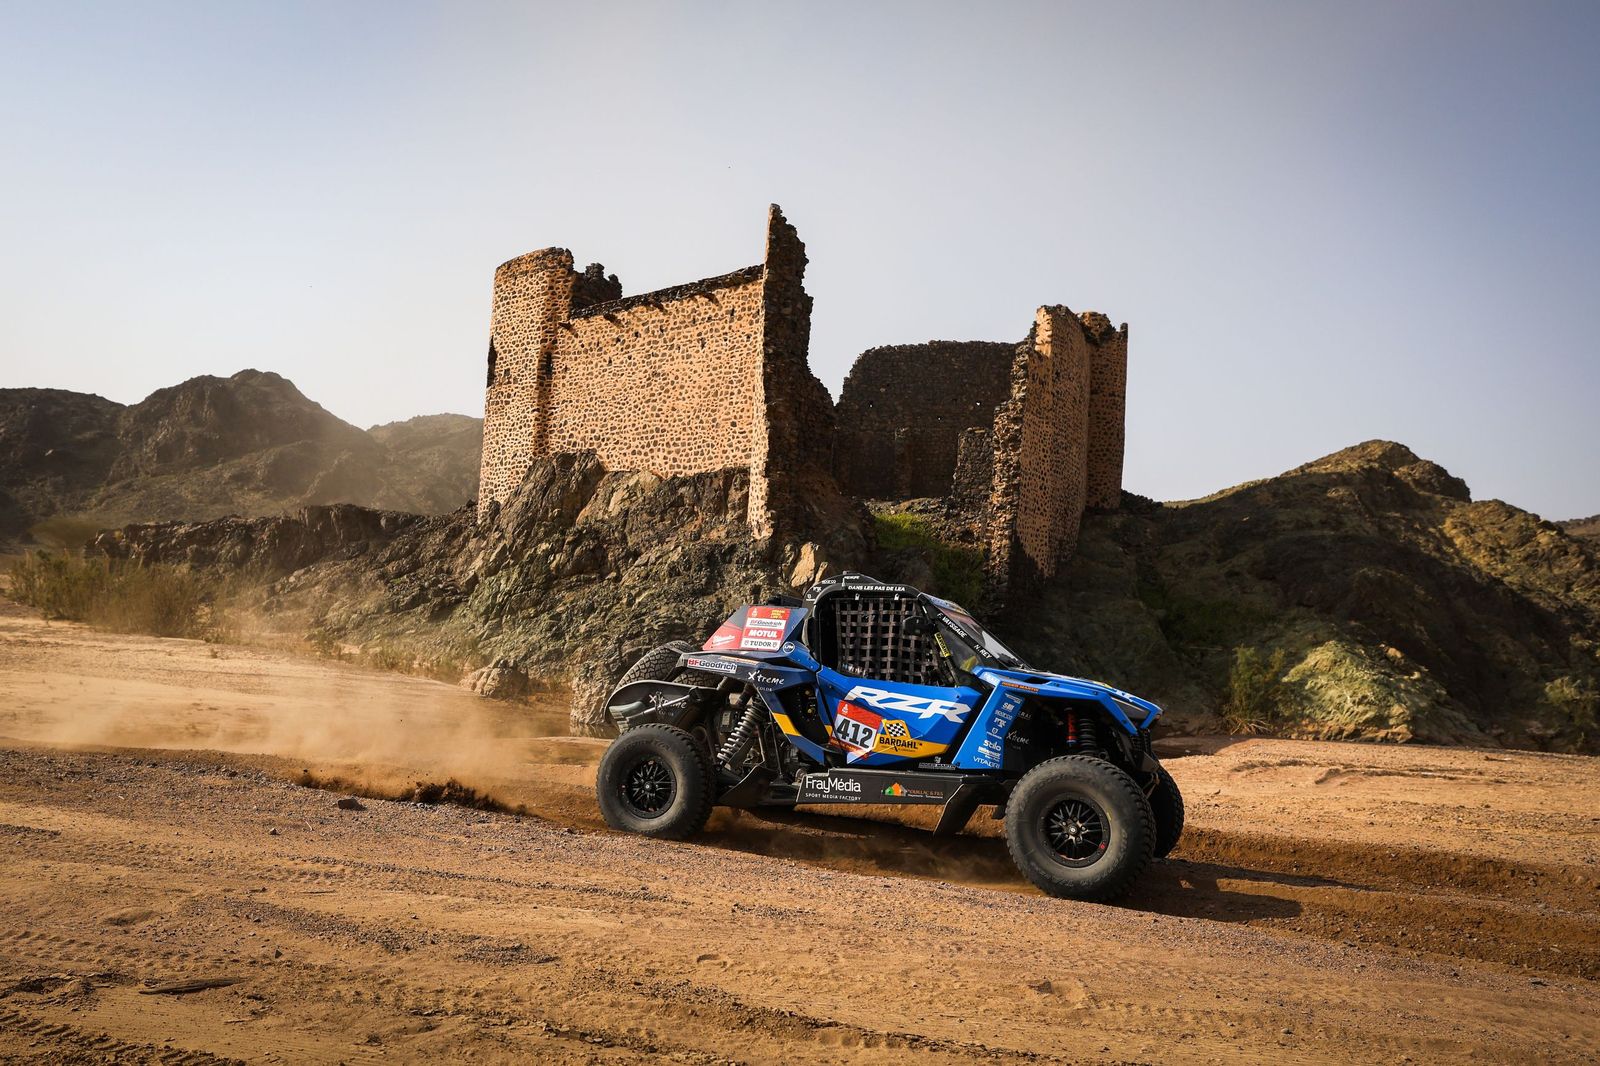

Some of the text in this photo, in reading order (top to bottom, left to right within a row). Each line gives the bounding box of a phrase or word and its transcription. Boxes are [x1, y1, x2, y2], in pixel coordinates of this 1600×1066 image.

[748, 629, 778, 638] MOTUL
[980, 649, 992, 659] REY
[688, 658, 737, 671] BFGoodrich
[843, 685, 972, 724] RZR
[836, 718, 873, 749] 412
[879, 736, 918, 750] BARDAHL
[805, 776, 862, 793] FrayMédia
